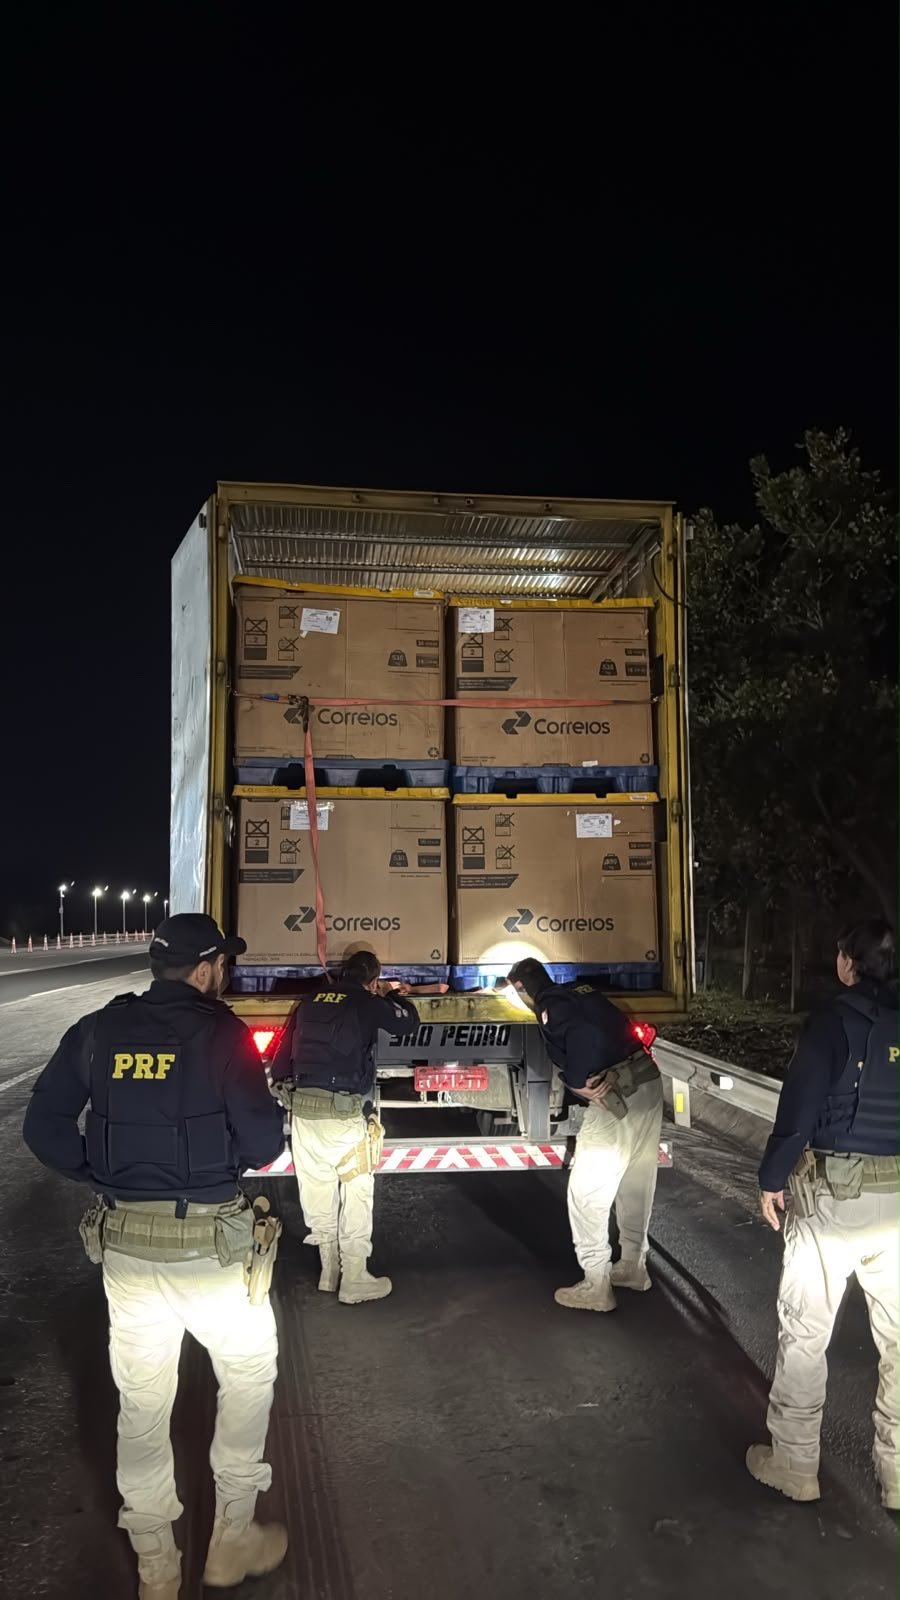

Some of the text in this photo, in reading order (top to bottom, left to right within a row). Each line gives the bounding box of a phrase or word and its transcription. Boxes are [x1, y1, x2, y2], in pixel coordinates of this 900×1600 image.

[317, 708, 398, 726] Correios
[533, 718, 611, 735] Correios
[324, 914, 401, 931] Correios
[536, 916, 614, 932] Correios
[313, 992, 349, 1004] PRF
[440, 1025, 511, 1047] PEDRO
[112, 1053, 176, 1080] PRF
